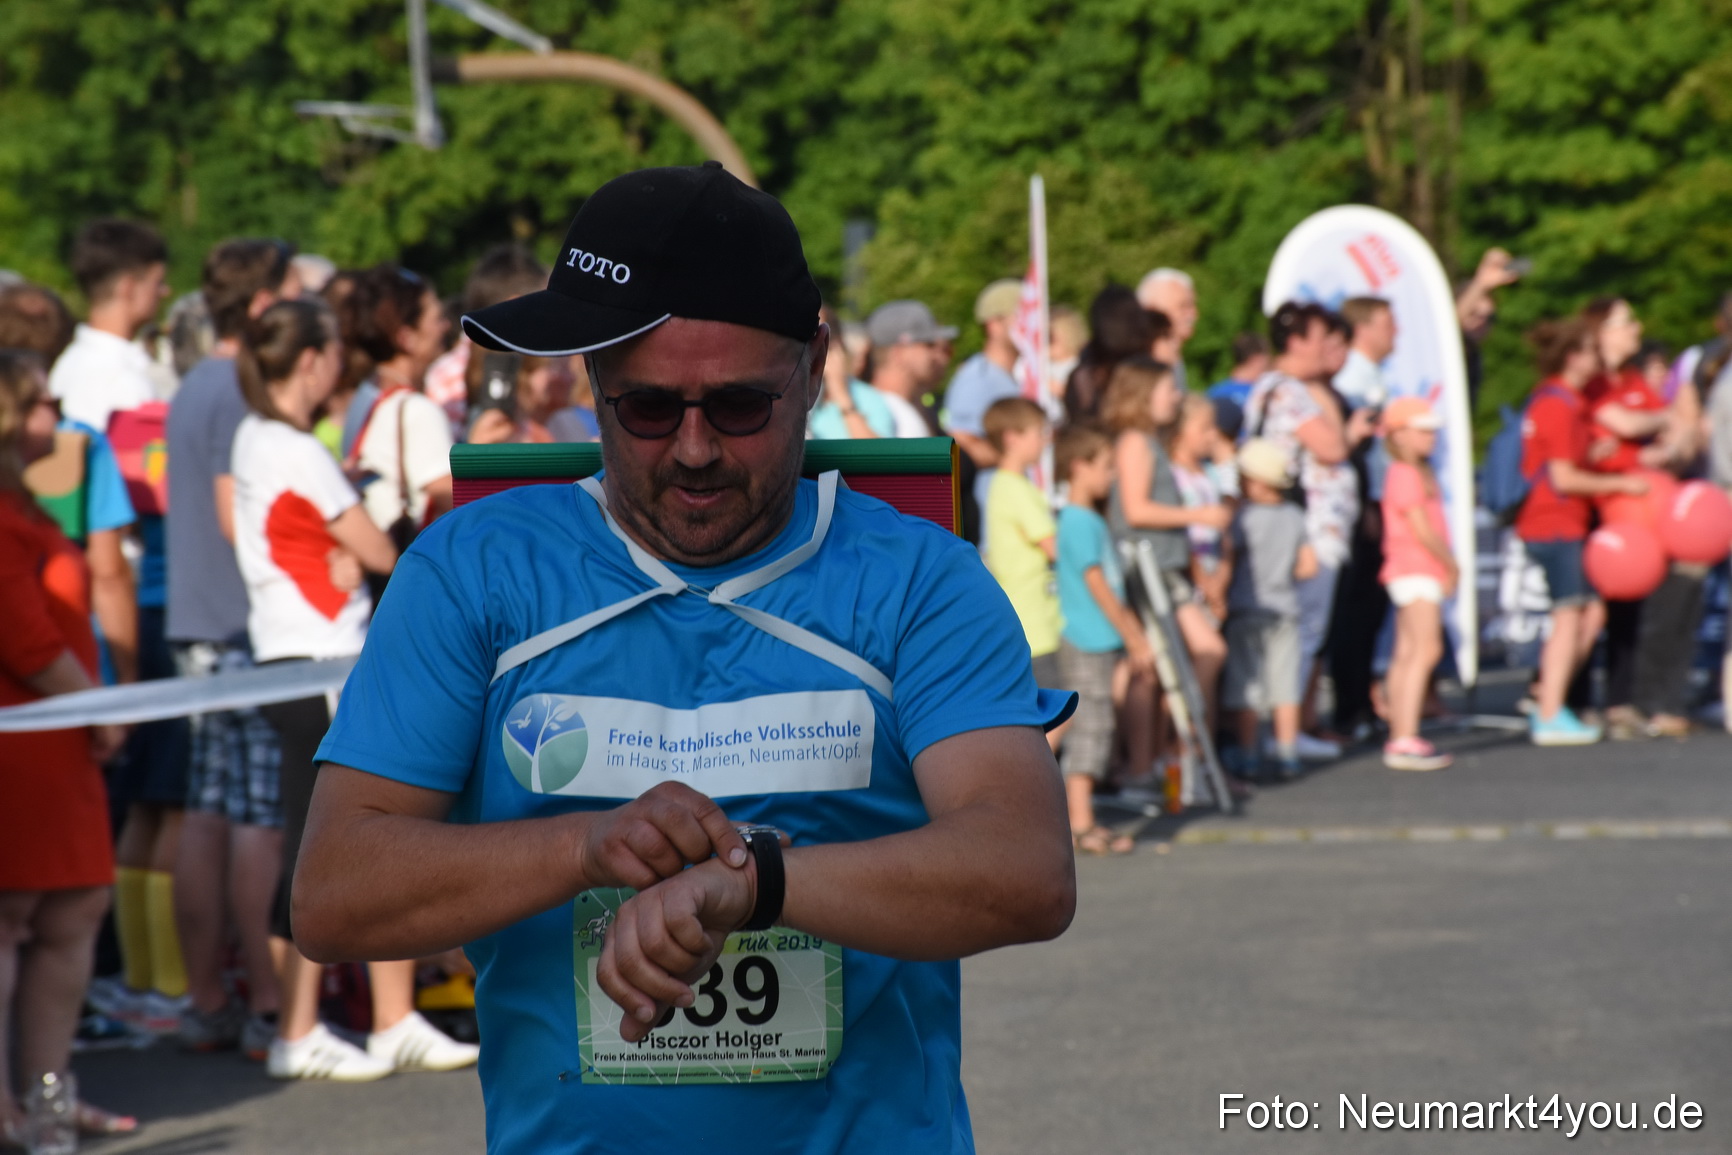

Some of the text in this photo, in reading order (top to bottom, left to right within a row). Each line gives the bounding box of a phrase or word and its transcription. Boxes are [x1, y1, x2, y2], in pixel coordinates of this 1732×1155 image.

[566, 247, 631, 284] TOTO
[608, 719, 861, 754] Freie katholische Volksschule
[606, 742, 862, 774] im Haus St. Marien, Neumarkt/Opf.
[776, 935, 822, 951] 2019
[652, 955, 780, 1028] 39
[594, 1047, 826, 1062] Freie Katholische Volksschule im Haus St. Marien
[716, 1030, 783, 1050] Holger
